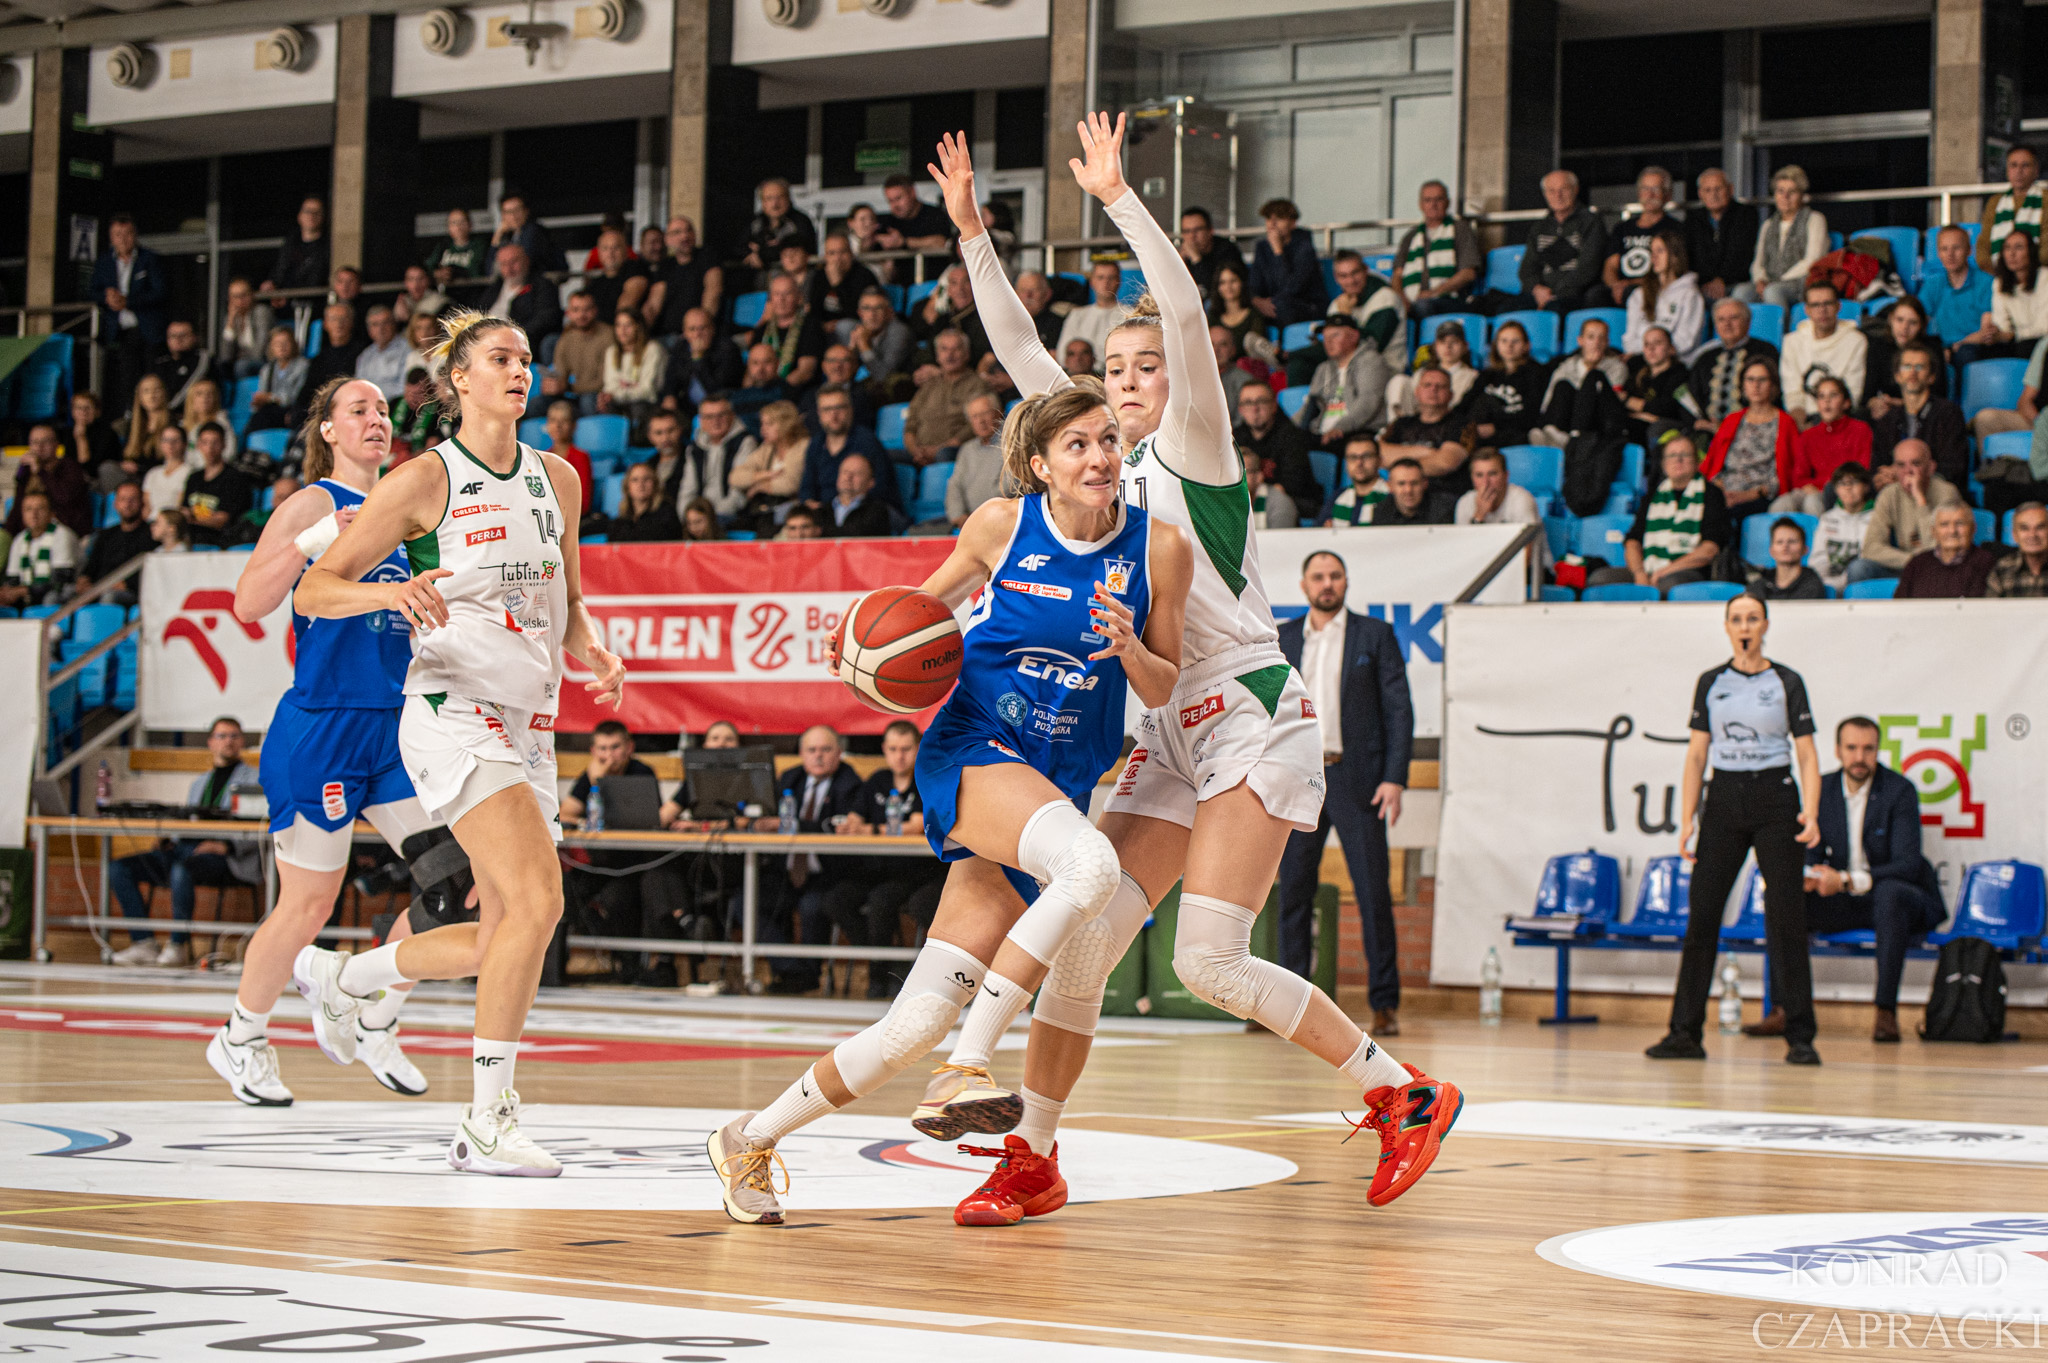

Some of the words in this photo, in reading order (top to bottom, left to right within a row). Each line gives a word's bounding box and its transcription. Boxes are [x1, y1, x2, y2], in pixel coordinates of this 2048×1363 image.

[460, 481, 484, 496] 4F
[453, 506, 479, 517] ORLEN
[532, 508, 558, 546] 14
[470, 528, 502, 543] PERŁA
[1017, 553, 1051, 572] 4F
[1003, 581, 1029, 592] ORLEN
[1017, 655, 1100, 691] Enea
